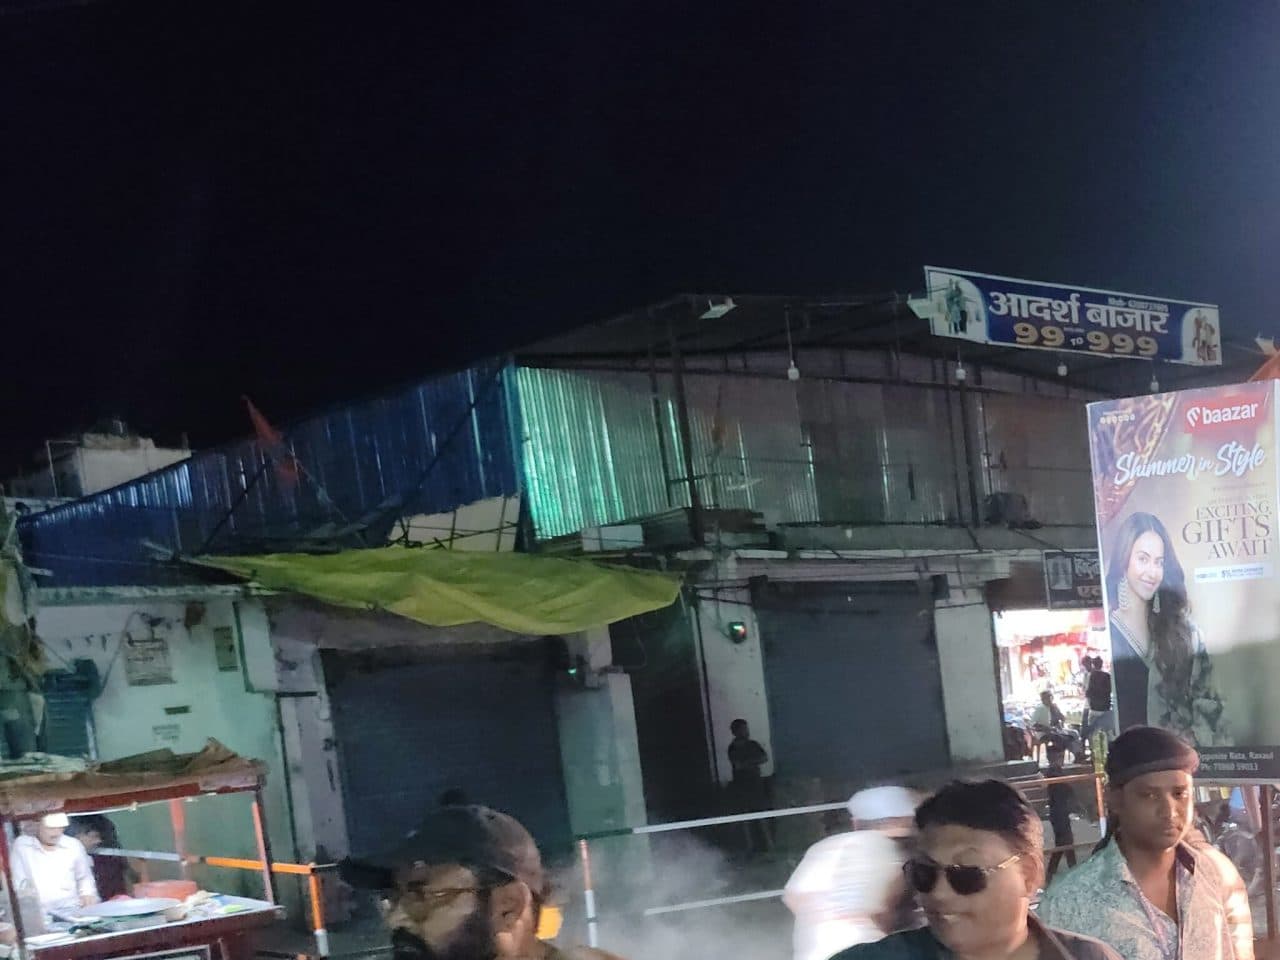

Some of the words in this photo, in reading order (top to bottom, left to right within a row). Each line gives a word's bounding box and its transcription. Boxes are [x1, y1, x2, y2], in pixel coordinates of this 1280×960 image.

[989, 292, 1081, 324] आदर्श
[1084, 302, 1170, 334] बाजार
[1013, 322, 1065, 347] 99
[1070, 336, 1084, 346] TO
[1086, 331, 1159, 356] 999
[1202, 403, 1259, 425] baazar
[1114, 451, 1196, 485] Shimmer
[1199, 456, 1213, 472] in
[1215, 440, 1265, 477] Style
[1195, 500, 1270, 520] EXCITING
[1182, 514, 1271, 545] GIFTS
[1207, 538, 1272, 560] AWAIT
